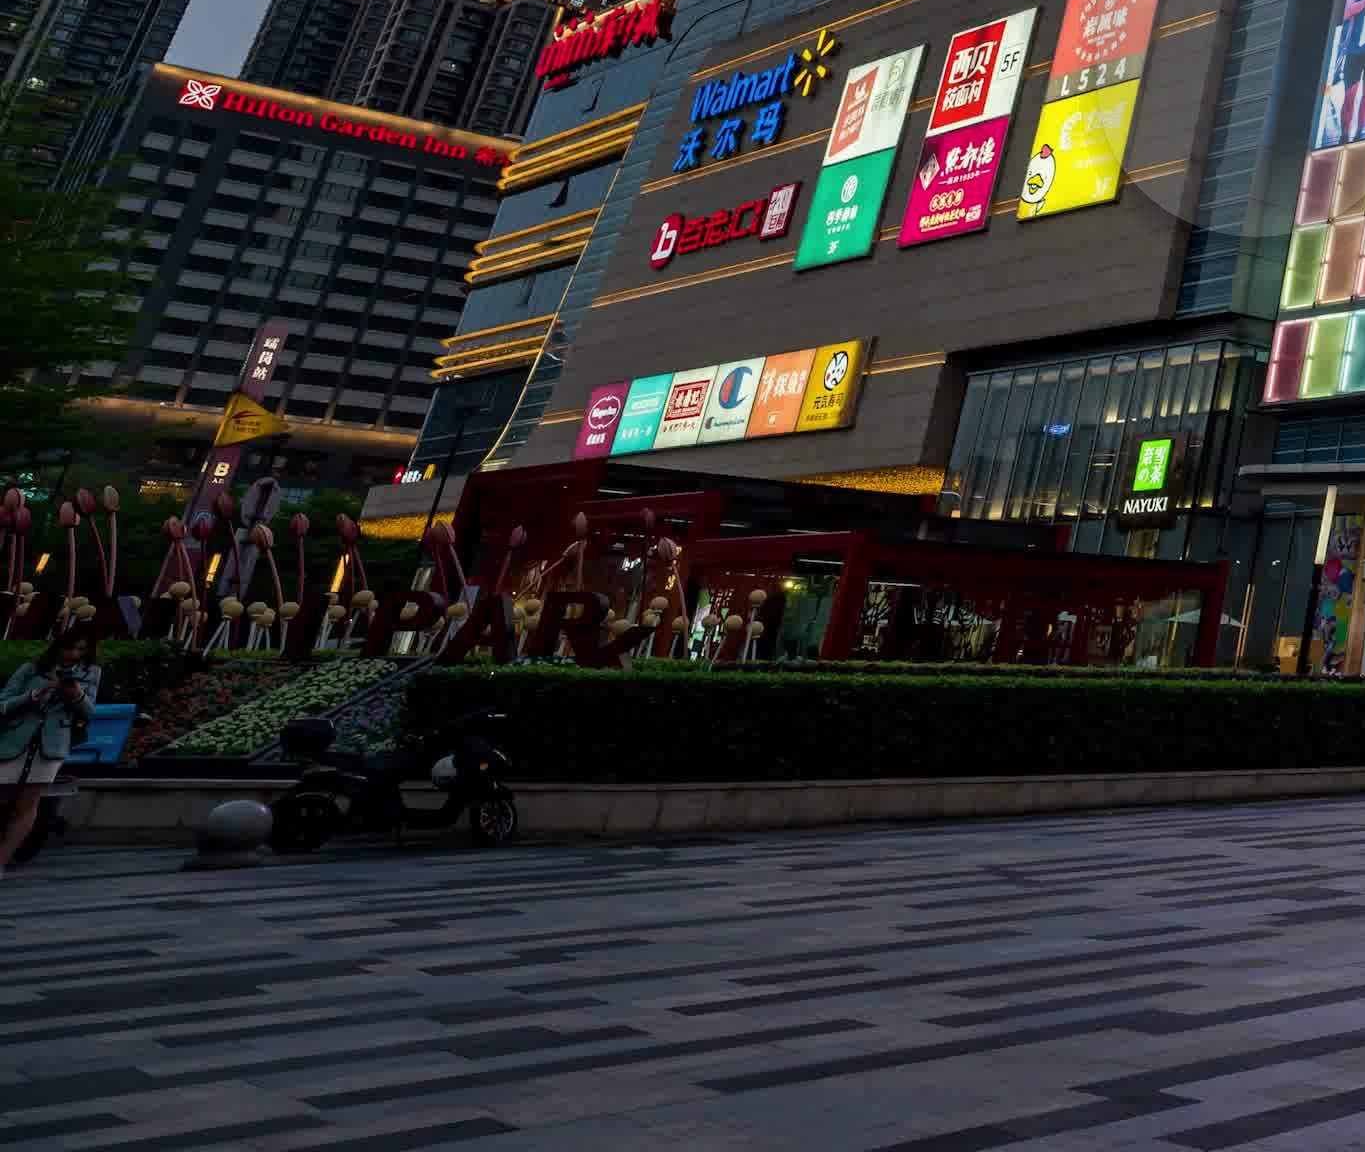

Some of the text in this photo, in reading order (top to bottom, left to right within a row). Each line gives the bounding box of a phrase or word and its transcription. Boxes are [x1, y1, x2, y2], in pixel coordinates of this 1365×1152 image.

[948, 41, 994, 85] 西贝
[1001, 51, 1020, 73] 5F
[690, 49, 798, 123] Walmart
[223, 91, 467, 161] Hilton Garden Inn
[672, 101, 785, 173] 沃尔玛
[214, 461, 231, 479] B
[1122, 496, 1169, 515] NAYUKI
